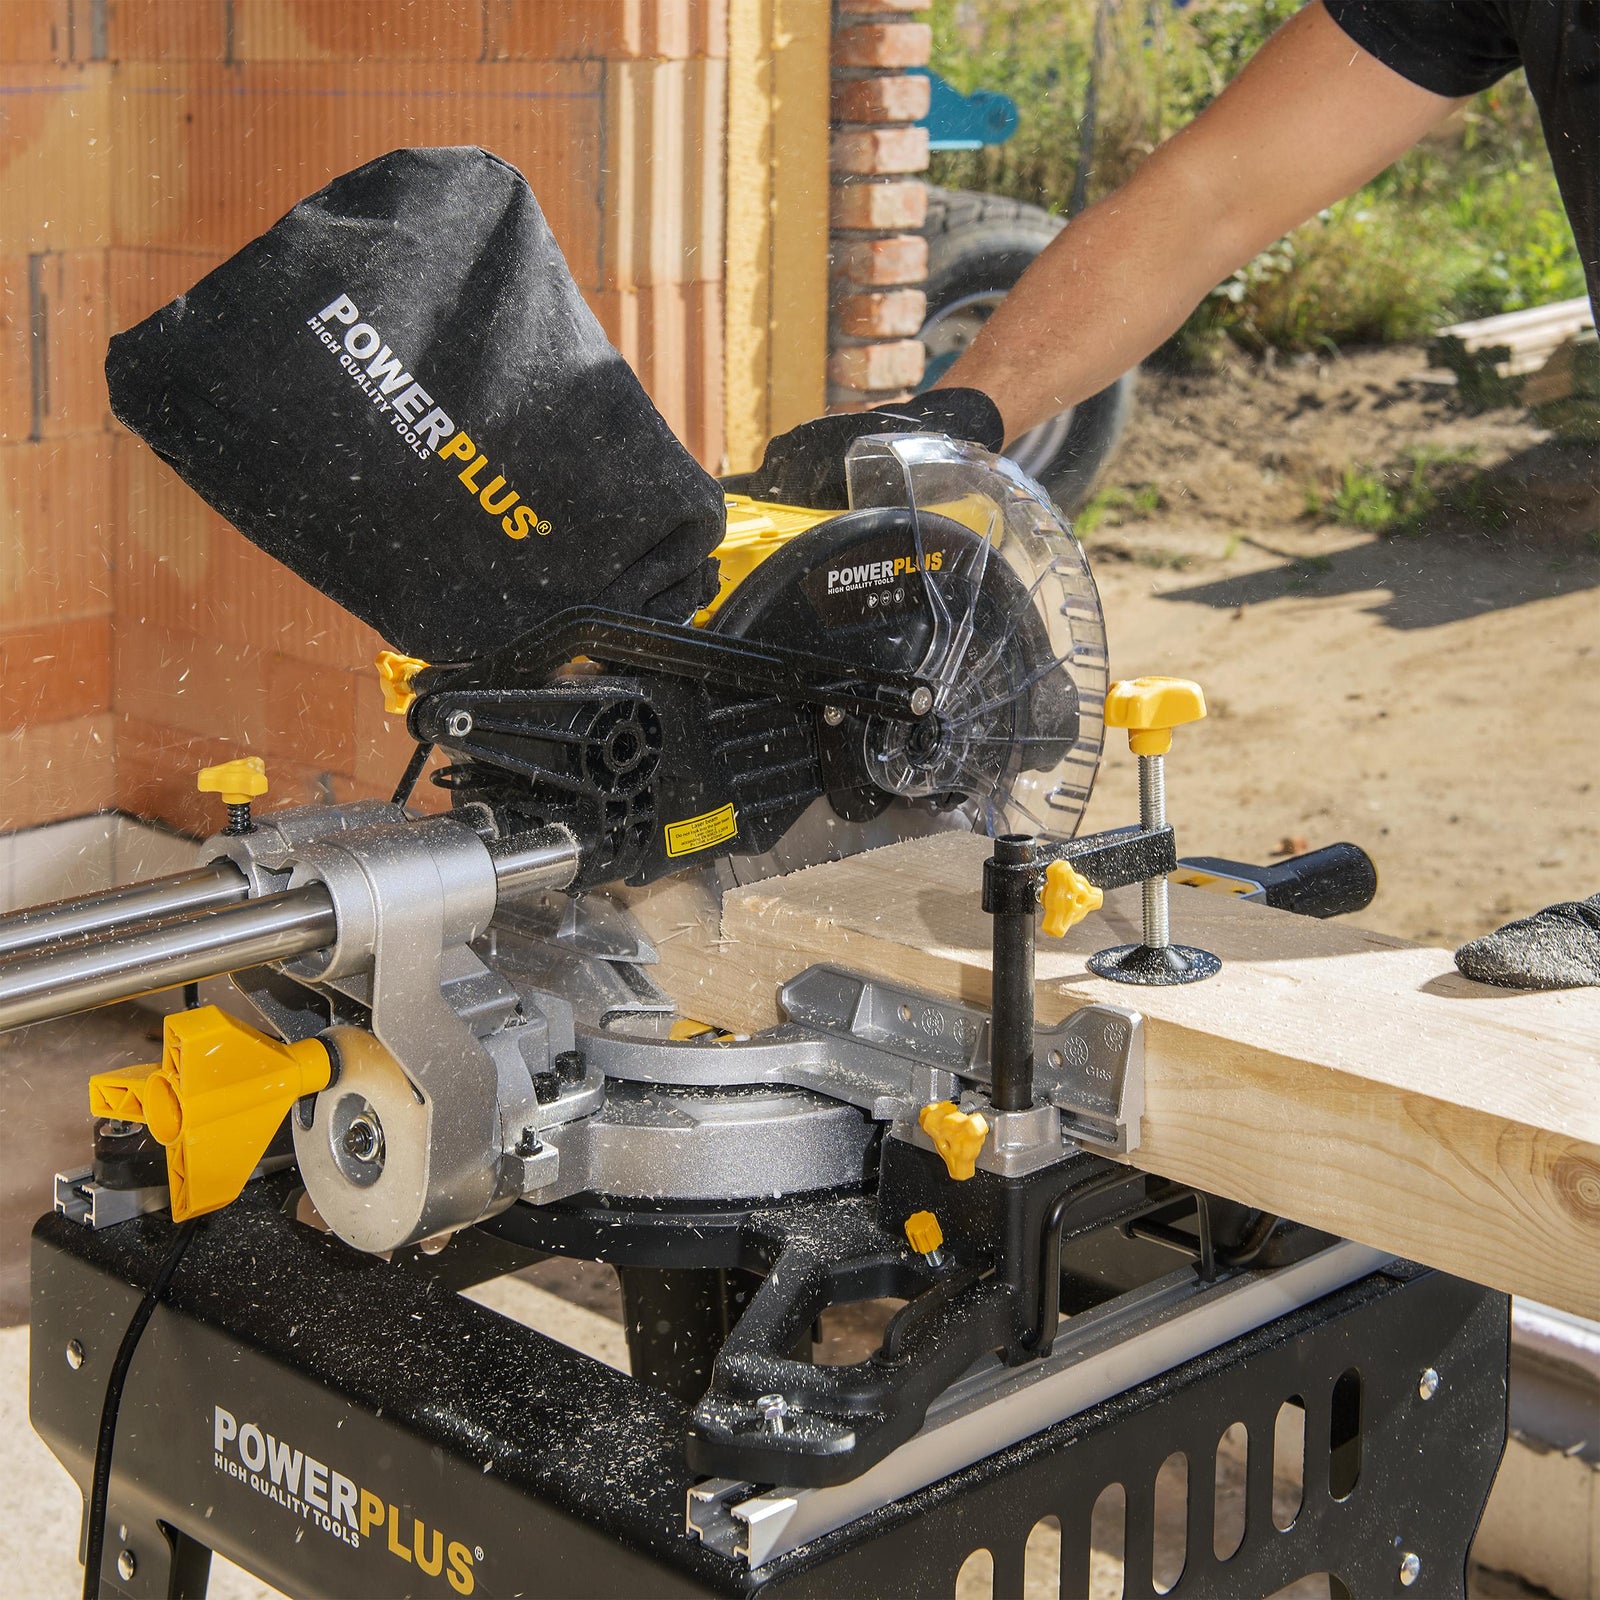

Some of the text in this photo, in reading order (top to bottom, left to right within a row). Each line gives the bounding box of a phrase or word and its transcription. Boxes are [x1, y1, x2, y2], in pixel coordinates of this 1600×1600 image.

[306, 316, 432, 461] HIGH QUALITY TOOLS
[827, 577, 895, 595] HIGH QUALITY TOOLS
[214, 1452, 360, 1549] HIGH QUALITY TOOLS
